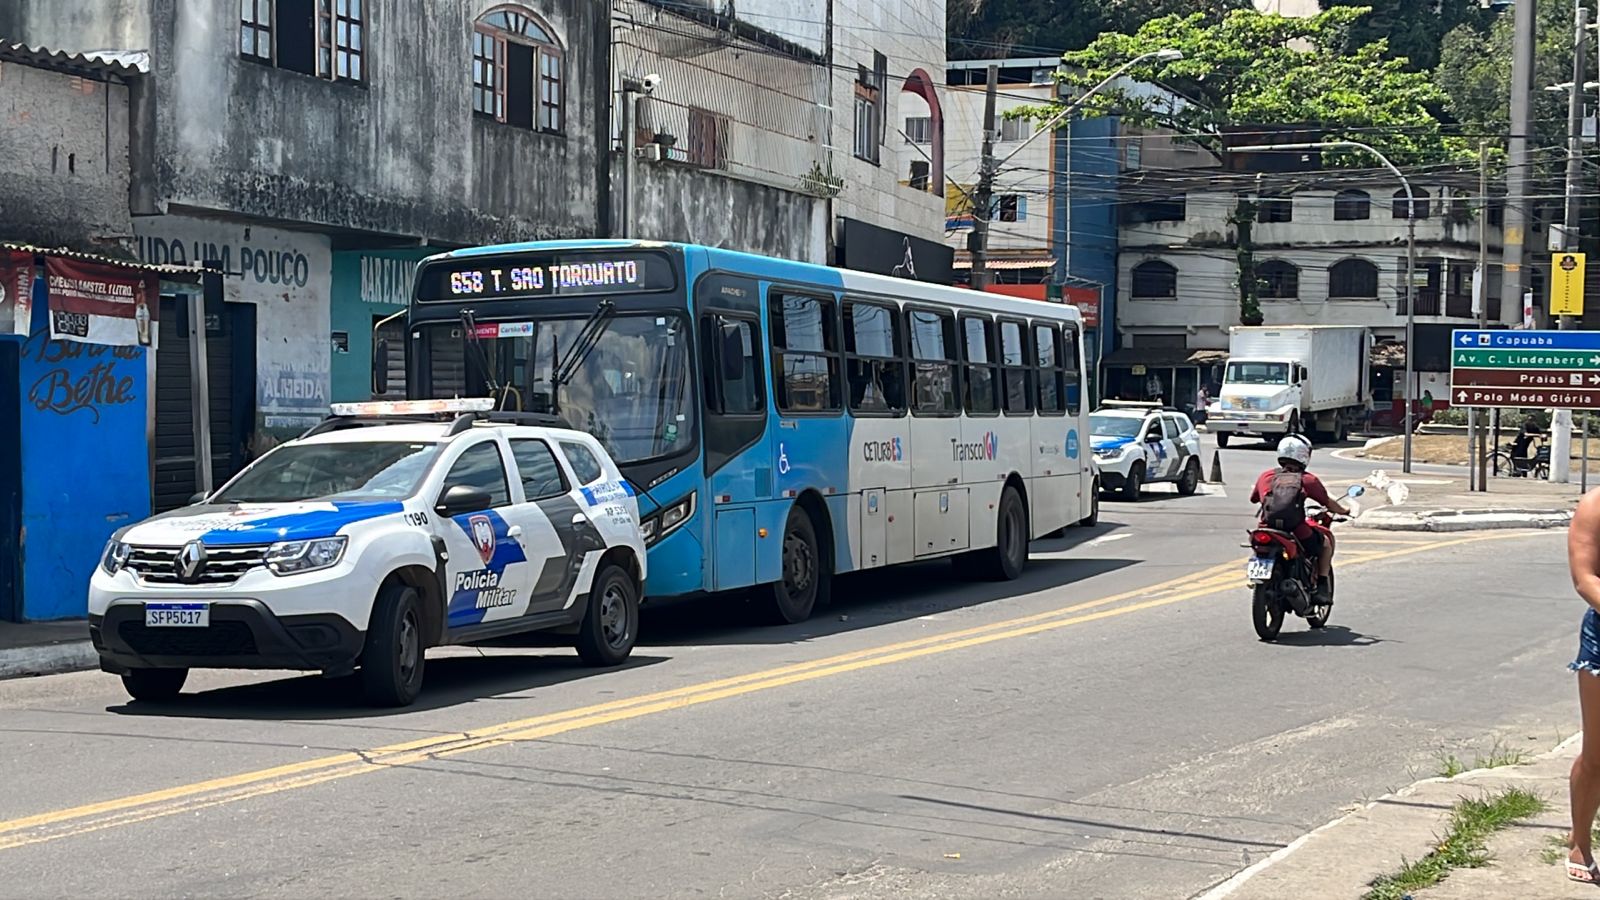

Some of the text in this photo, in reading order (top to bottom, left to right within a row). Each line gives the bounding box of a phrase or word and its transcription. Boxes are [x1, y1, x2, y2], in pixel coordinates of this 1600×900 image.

[240, 247, 309, 289] POUCO
[450, 260, 637, 294] 658 T. SAO TORQUATO
[79, 279, 106, 294] AMSTEL
[361, 255, 382, 302] BAR
[383, 258, 391, 304] E
[1496, 336, 1553, 346] Capuaba
[1458, 354, 1584, 366] Av. C. Lindenberg
[1519, 374, 1564, 384] Praias
[28, 362, 137, 424] Bethe
[264, 377, 325, 401] ALMEIDA
[1474, 391, 1592, 403] Polo Moda Glória
[409, 511, 429, 527] 190
[455, 569, 499, 592] Polícia
[475, 589, 517, 610] Militar
[151, 611, 202, 624] SFP5C17
